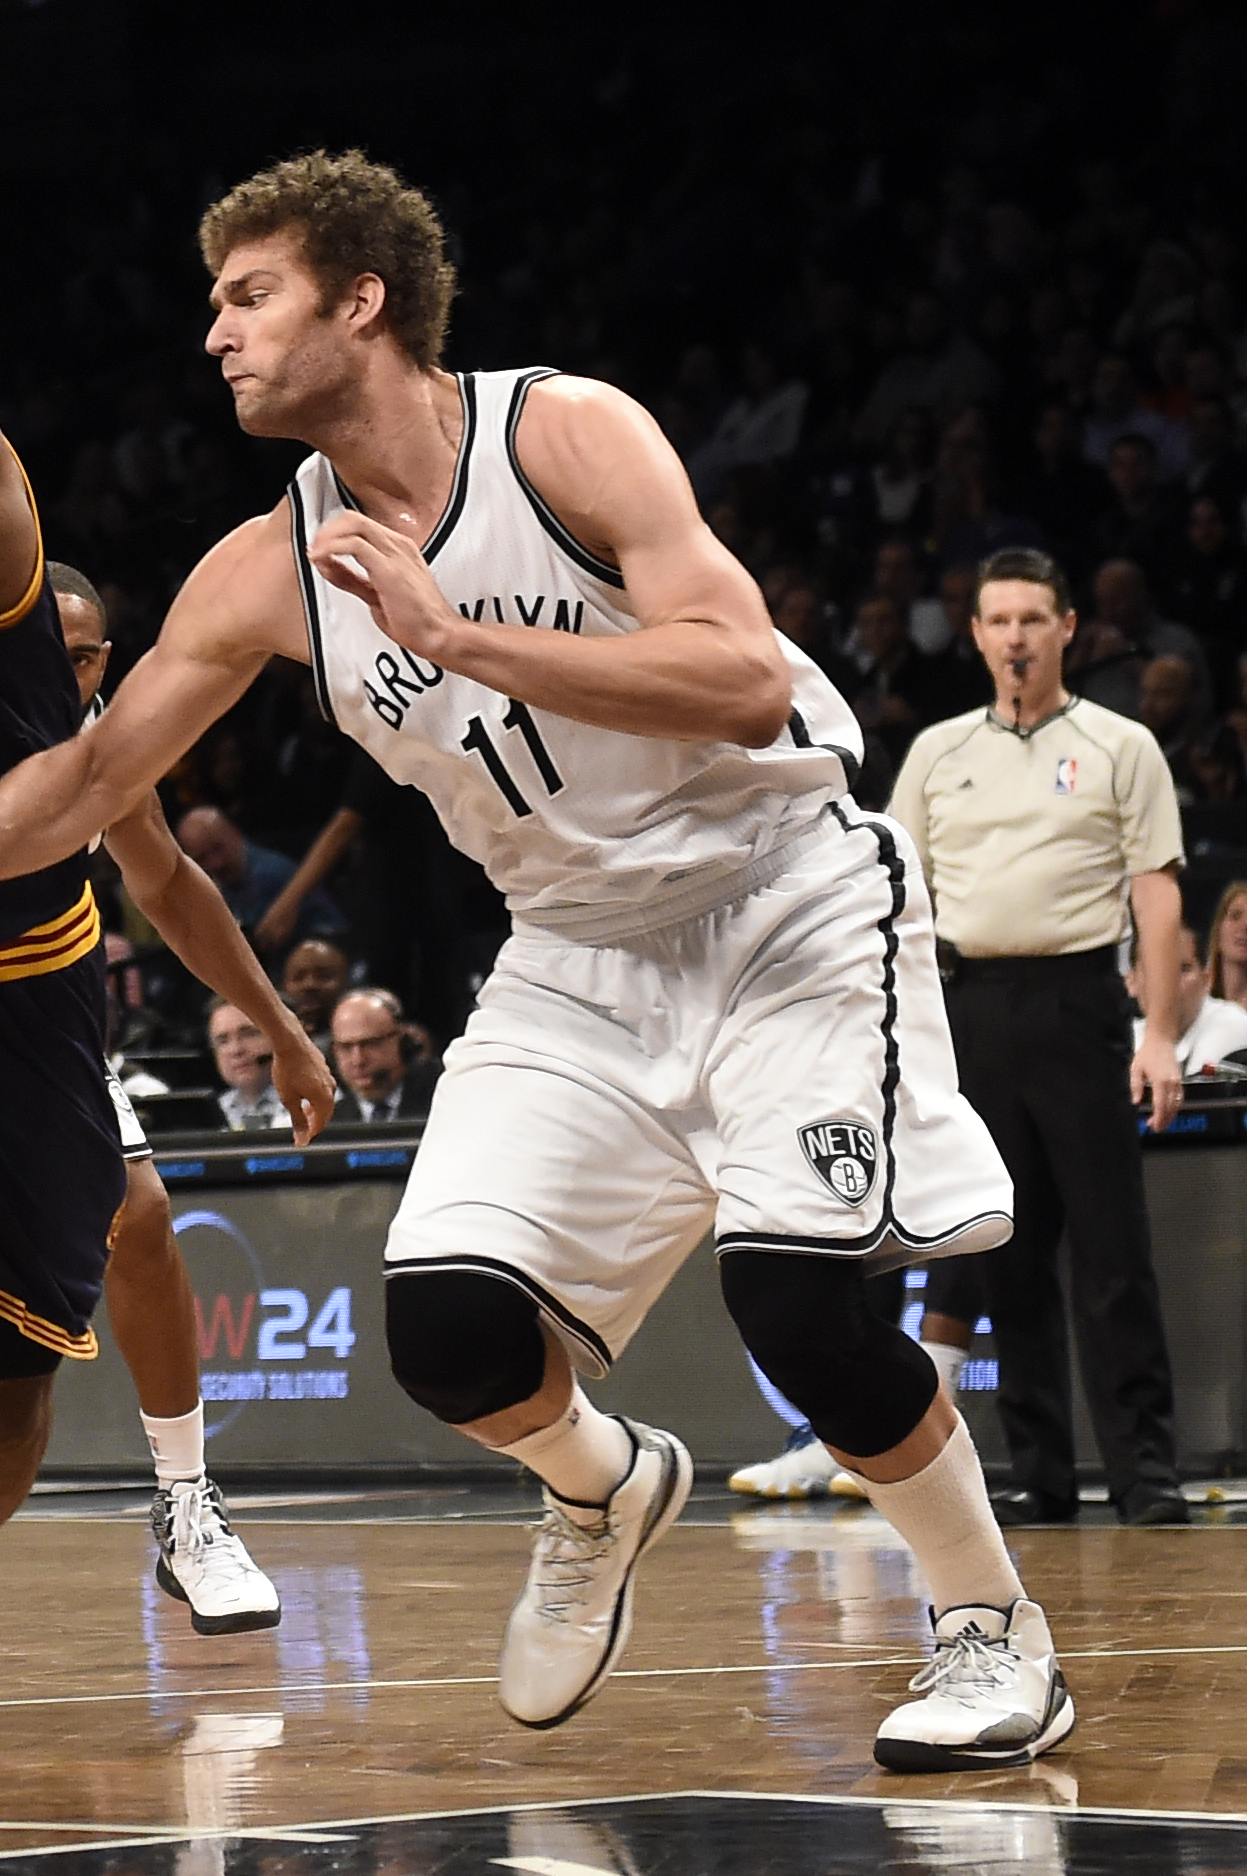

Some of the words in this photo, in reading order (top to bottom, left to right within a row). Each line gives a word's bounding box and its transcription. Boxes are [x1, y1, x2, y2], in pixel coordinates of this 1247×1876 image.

[460, 697, 565, 818] 11
[805, 1125, 875, 1160] NETS
[842, 1163, 857, 1192] B
